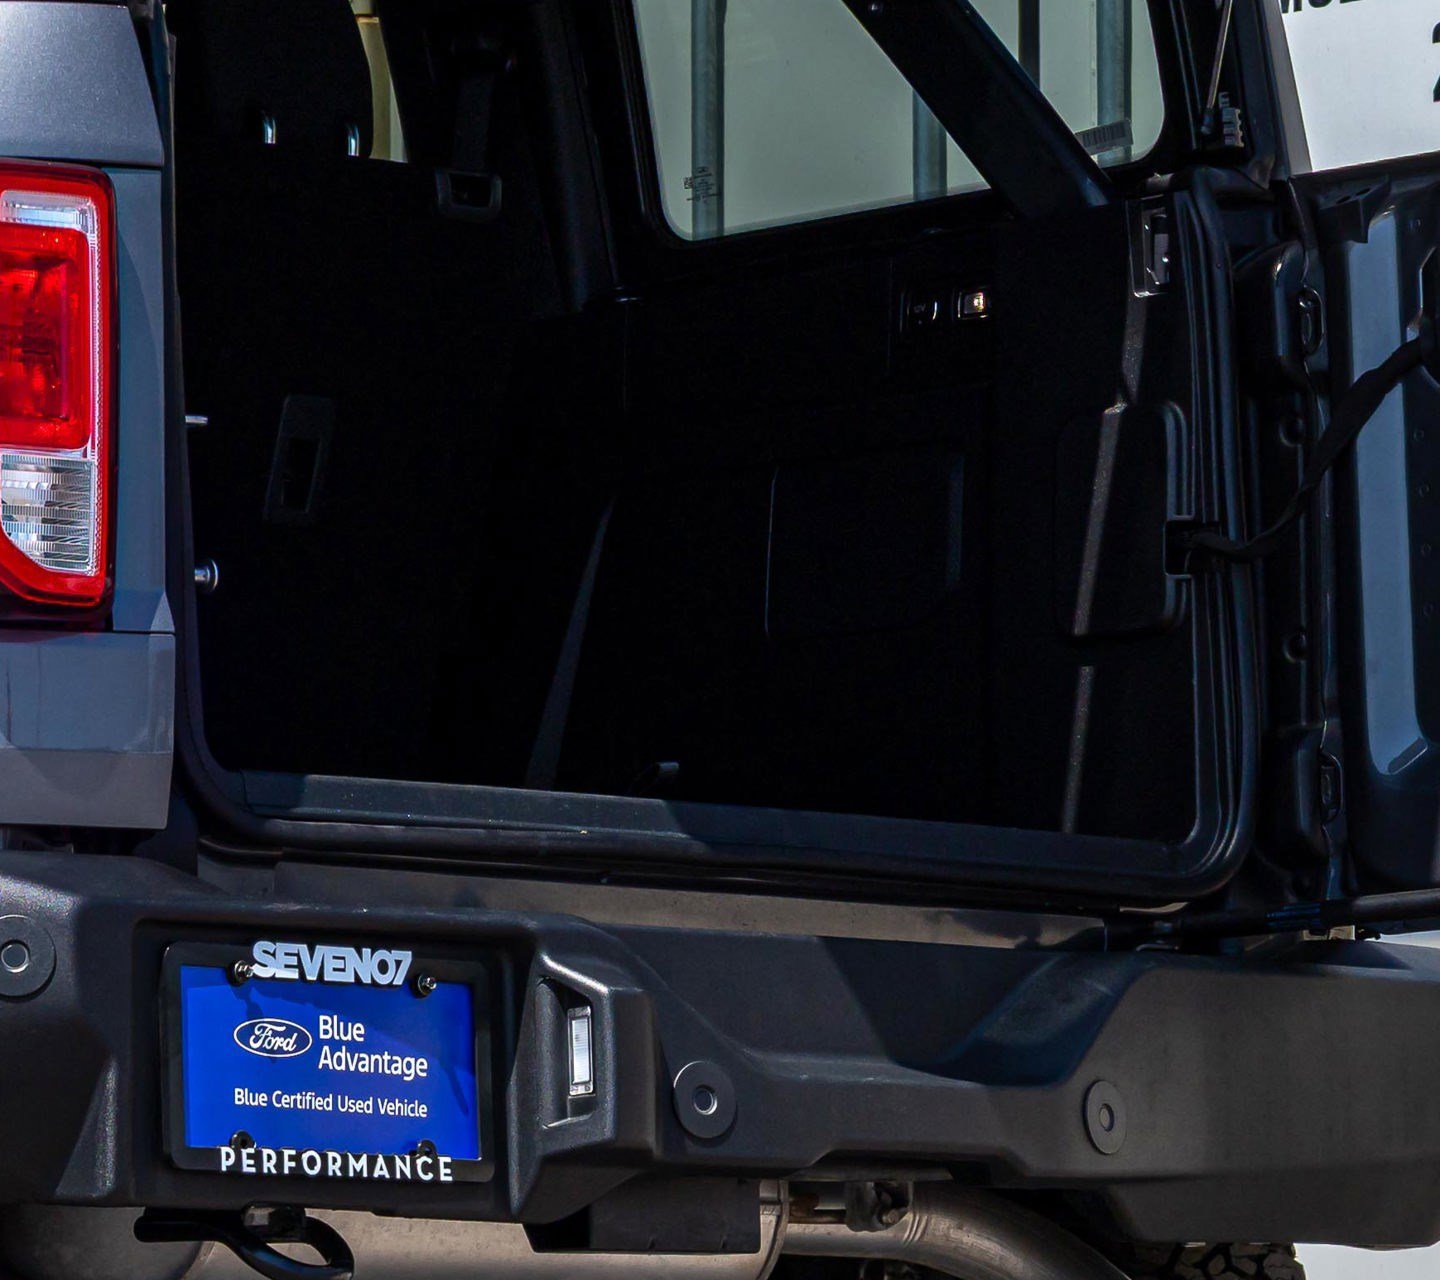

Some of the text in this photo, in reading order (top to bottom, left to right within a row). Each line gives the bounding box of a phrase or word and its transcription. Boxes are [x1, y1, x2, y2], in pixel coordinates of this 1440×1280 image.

[249, 1022, 297, 1052] Ford
[319, 1014, 365, 1042] Blue
[318, 1045, 428, 1082] Advantage
[234, 1087, 428, 1118] Blue Certified Used Vehicle
[219, 1146, 454, 1182] PERFORMANCE
